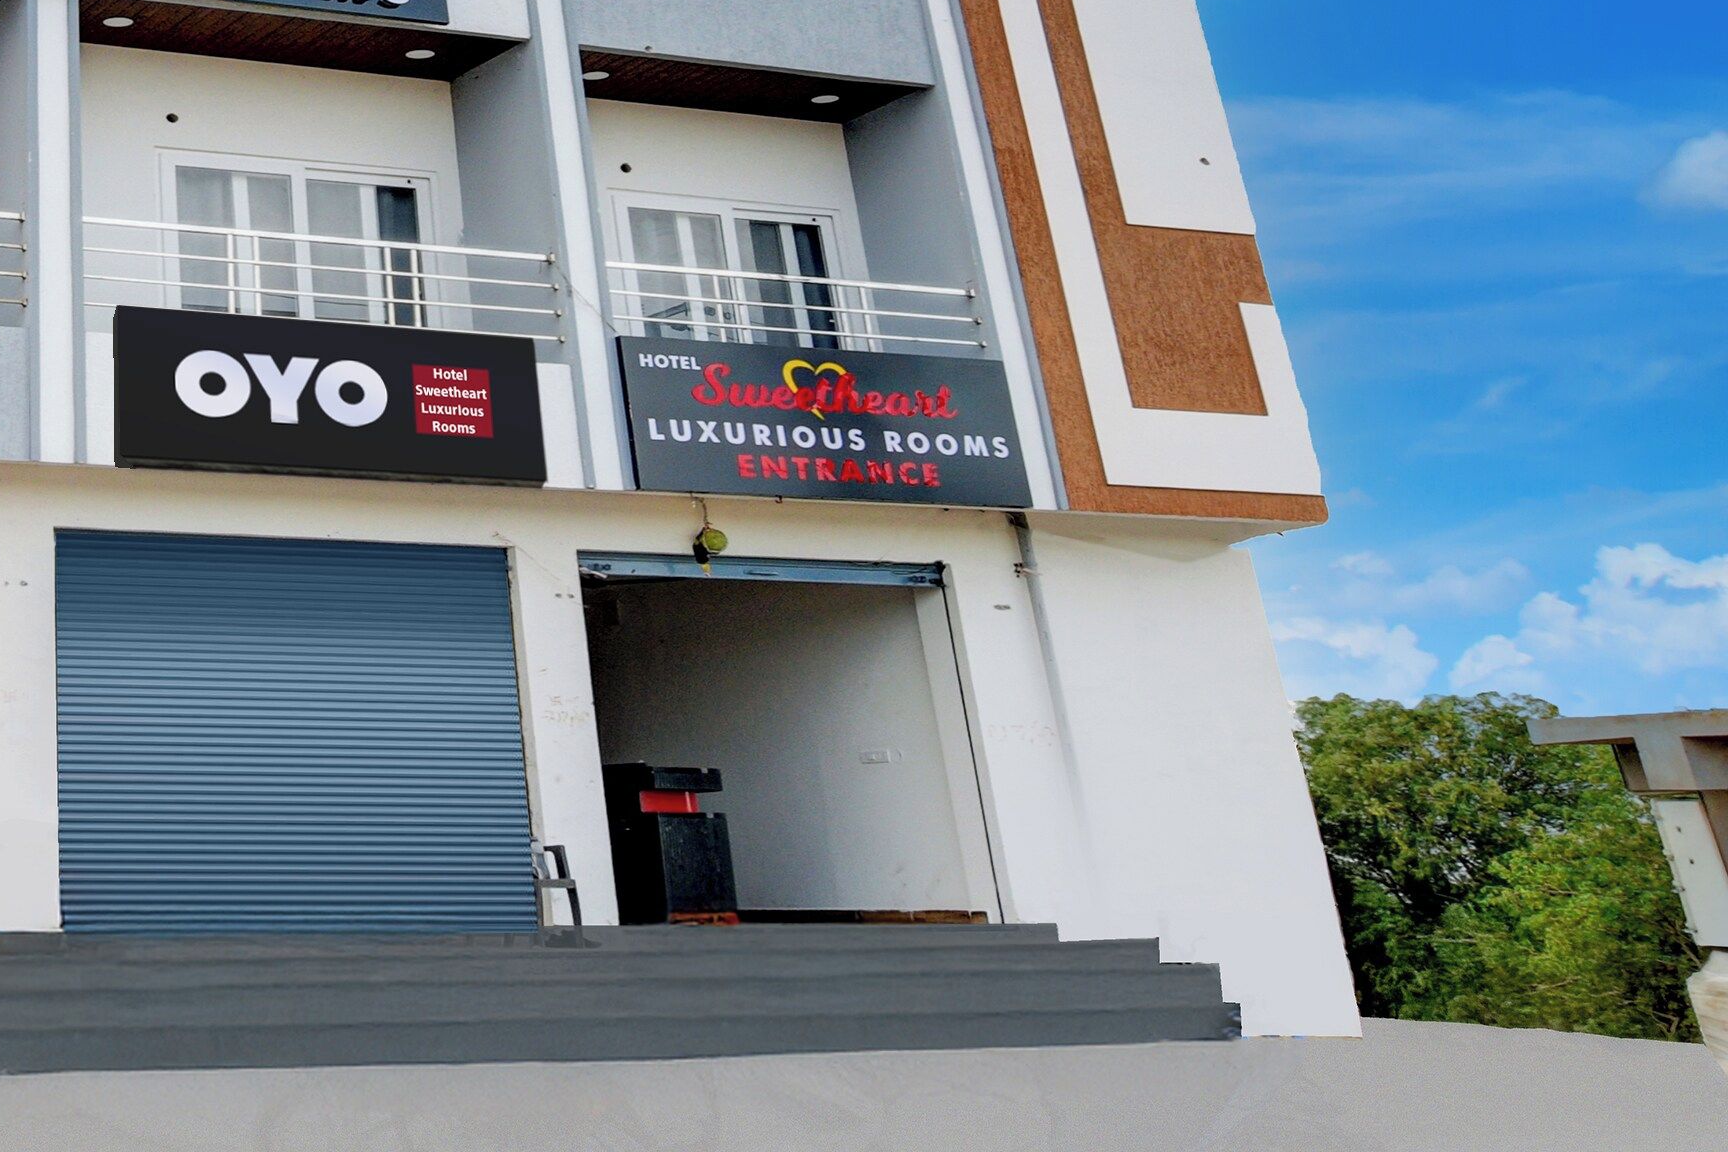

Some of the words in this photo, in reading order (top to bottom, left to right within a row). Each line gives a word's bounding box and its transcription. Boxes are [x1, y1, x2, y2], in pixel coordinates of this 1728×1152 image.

[432, 367, 468, 382] Hotel
[638, 353, 702, 371] HOTEL
[174, 349, 389, 428] OYO
[415, 384, 488, 400] Sweetheart
[691, 361, 959, 420] Sweetheart
[432, 420, 477, 435] Rooms
[648, 417, 867, 452] LUXURIOUS
[883, 429, 1011, 460] ROOMS
[737, 454, 942, 488] ENTRANCE
